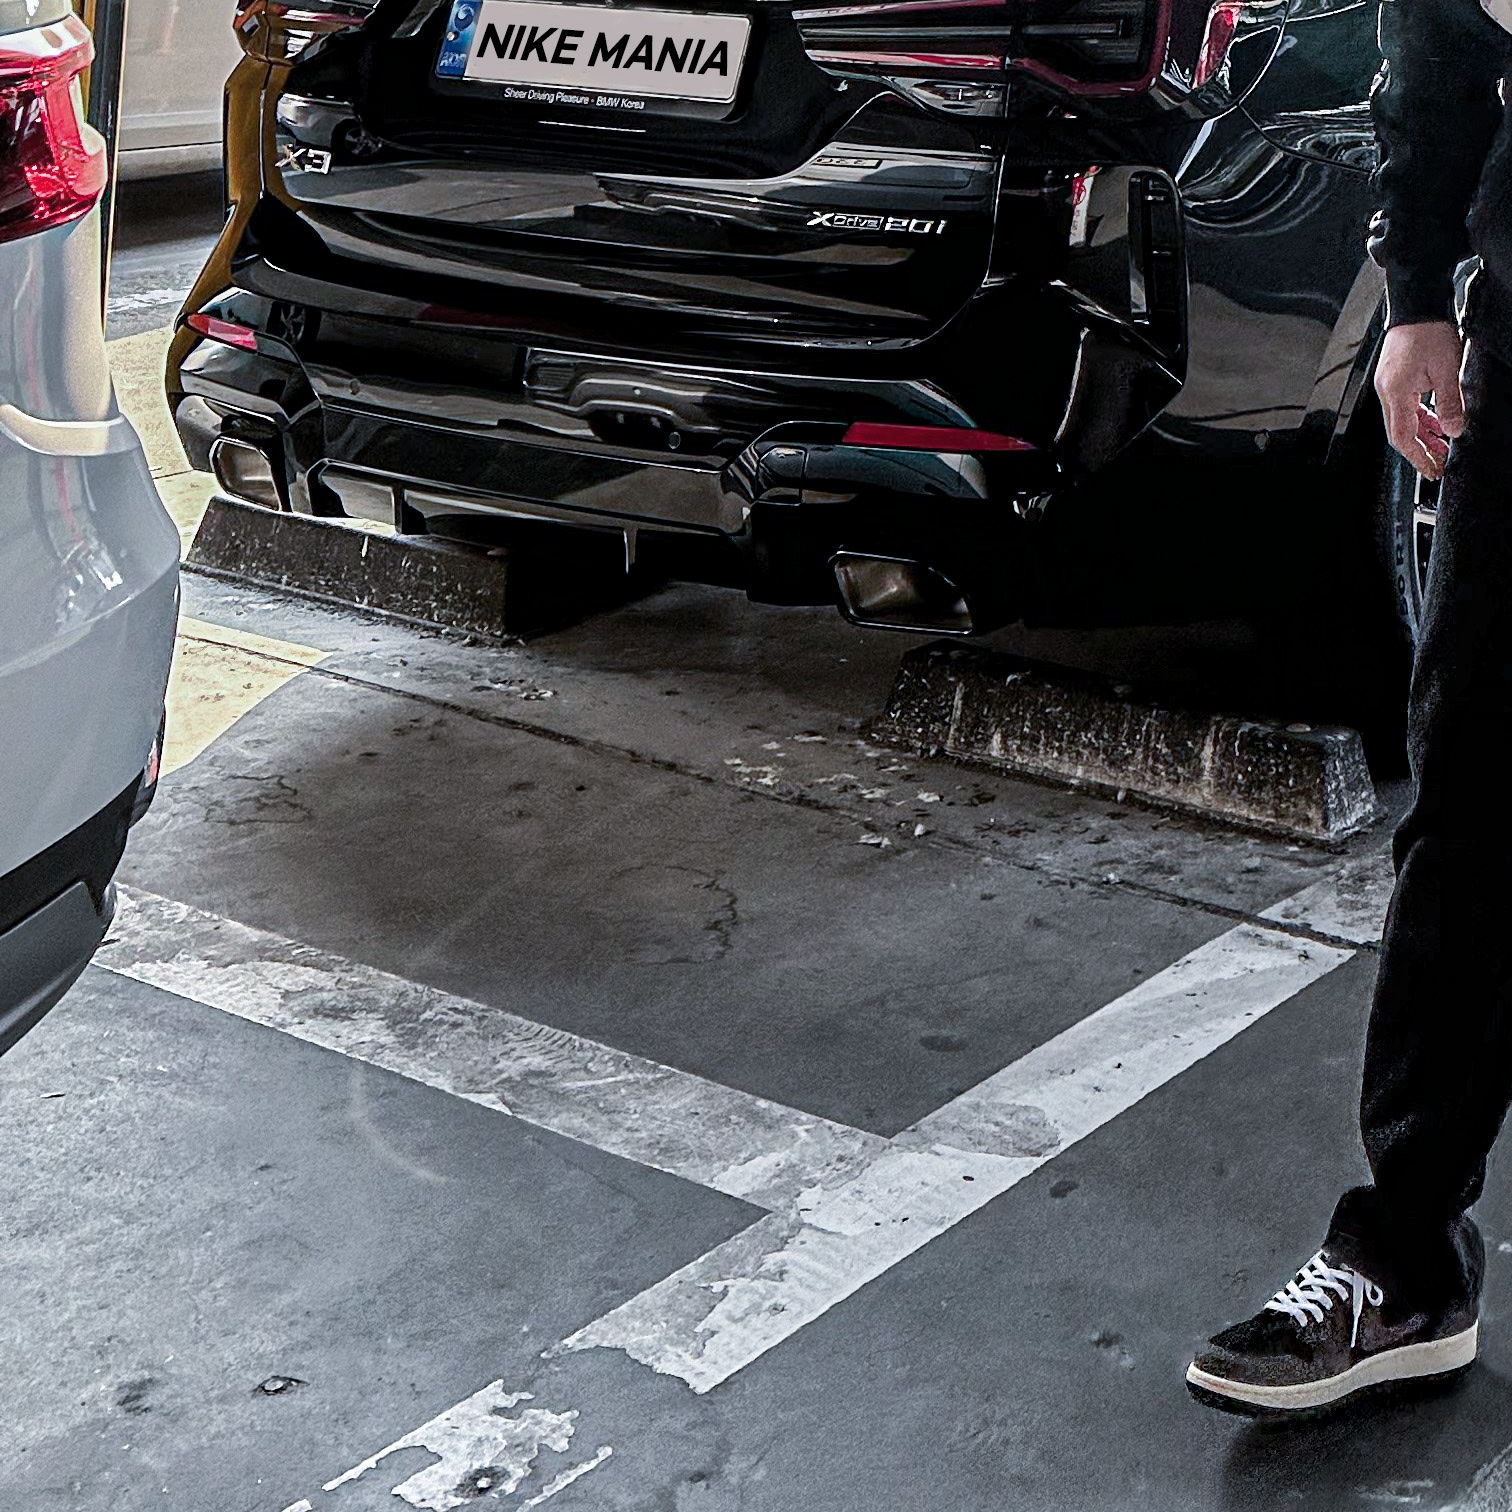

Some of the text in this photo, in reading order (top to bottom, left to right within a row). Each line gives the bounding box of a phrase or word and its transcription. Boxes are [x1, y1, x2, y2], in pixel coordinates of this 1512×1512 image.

[476, 22, 729, 77] NIKE MANIA
[504, 87, 645, 110] Sheer Driving Pleasure BMW Korea
[275, 143, 332, 175] X3
